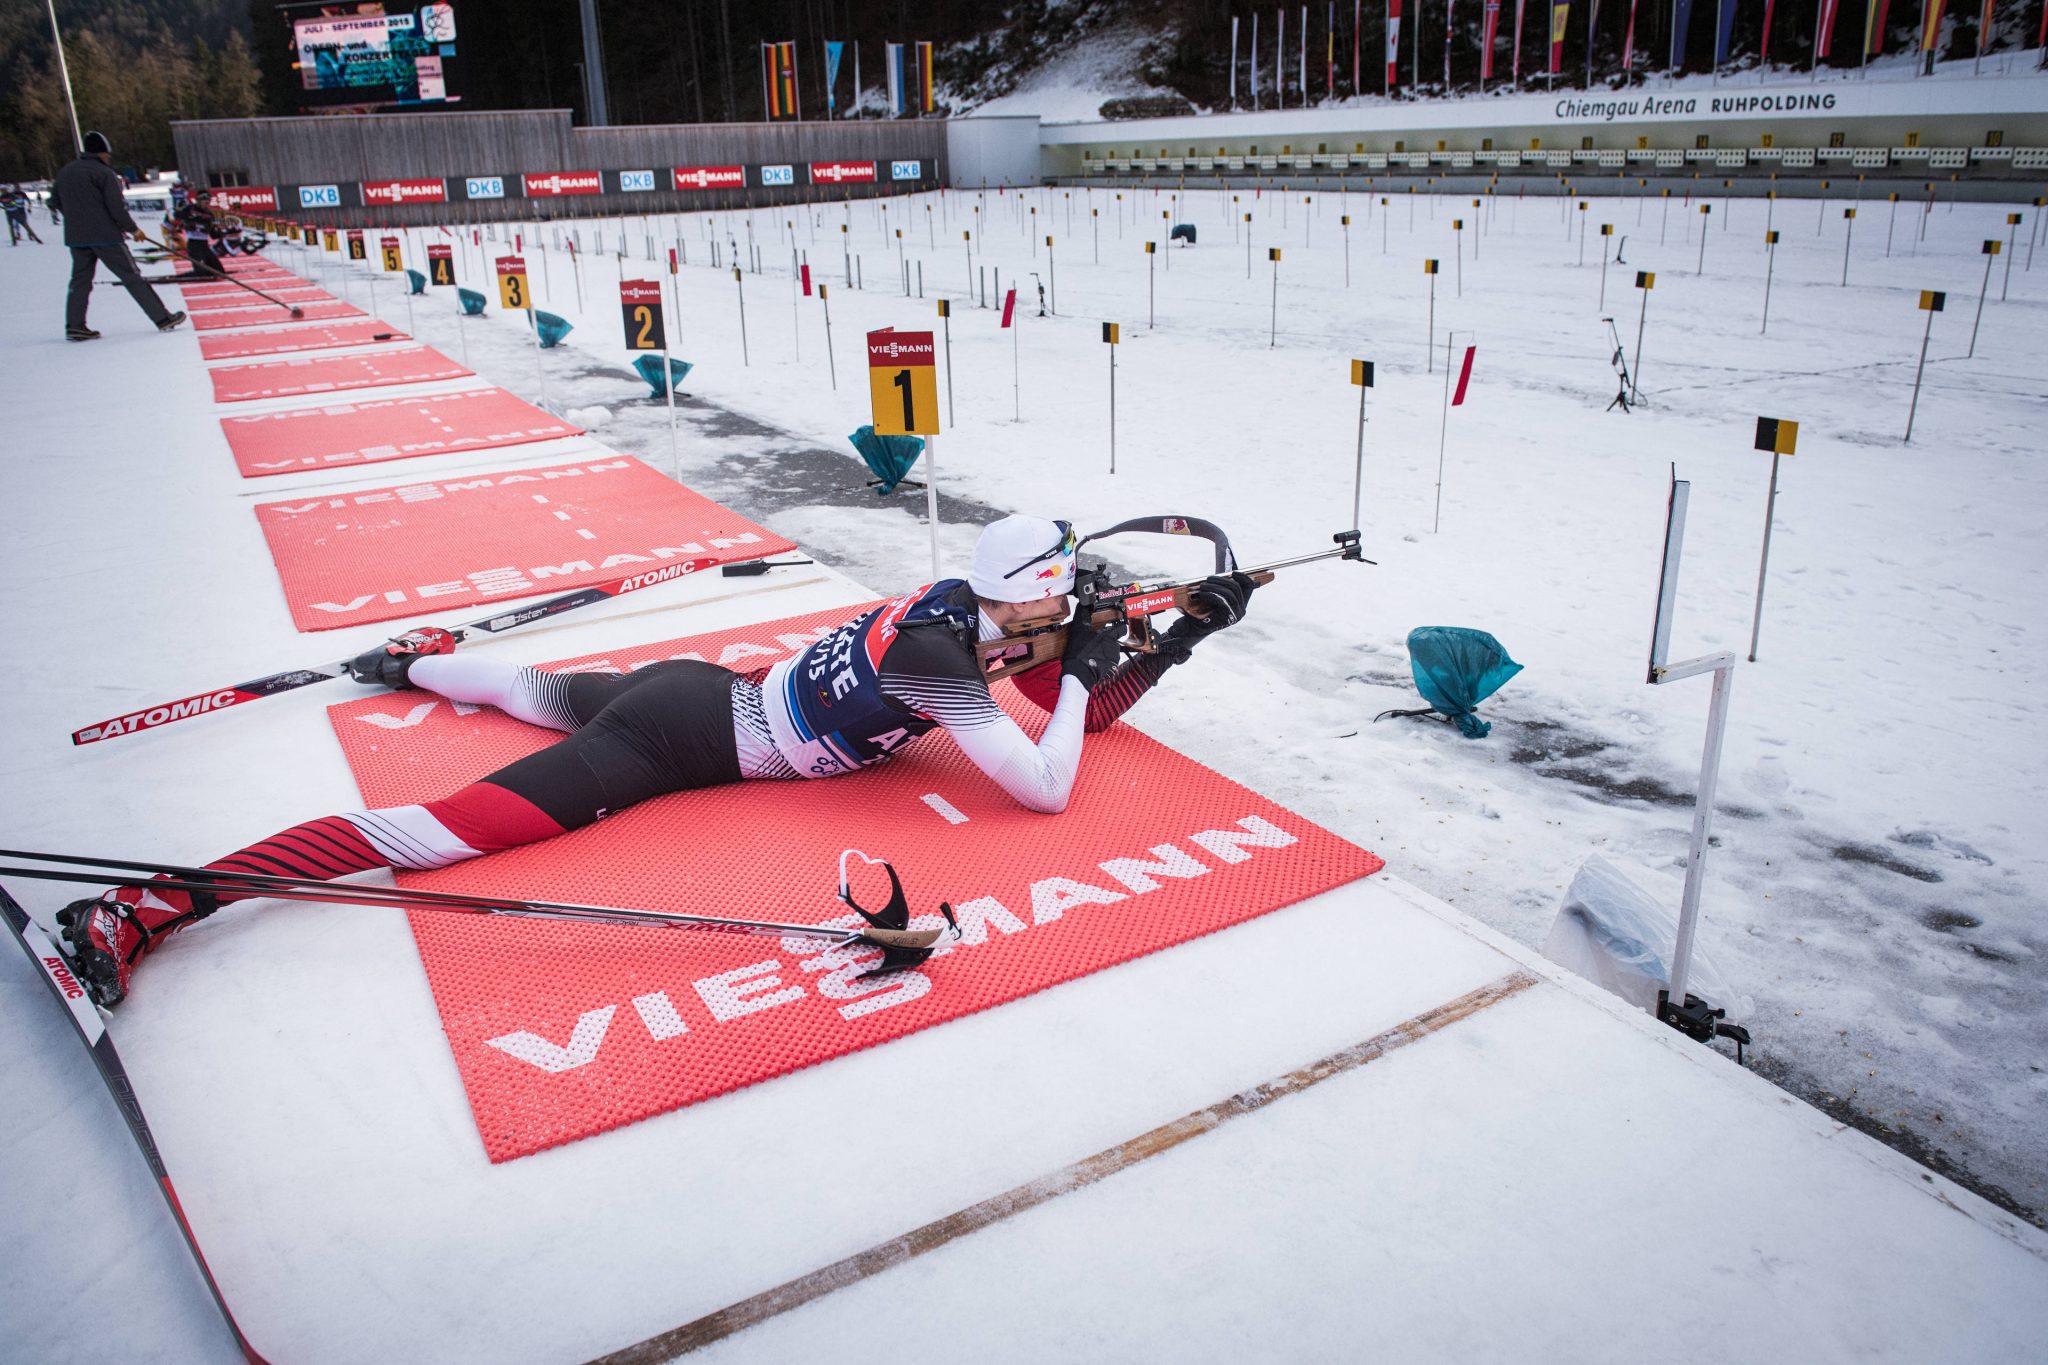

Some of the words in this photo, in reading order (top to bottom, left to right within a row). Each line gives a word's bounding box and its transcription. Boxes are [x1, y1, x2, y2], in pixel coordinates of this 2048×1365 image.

[304, 26, 323, 34] JULI
[332, 20, 385, 31] SEPTEMBER
[1555, 99, 1638, 121] Chiemgau
[1642, 97, 1696, 115] Arena
[1711, 94, 1836, 113] RUHPOLDING
[676, 169, 742, 187] VIESSMANN
[764, 167, 793, 182] DKB
[813, 164, 873, 181] VIESSMANN
[894, 164, 919, 176] DKB
[468, 179, 502, 195] DKB
[527, 175, 598, 194] VIESSMANN
[622, 175, 652, 189] DKB
[301, 187, 337, 204] DKB
[366, 182, 443, 202] VIESSMANN
[328, 235, 335, 251] 7
[352, 240, 361, 258] 6
[387, 249, 397, 271] 5
[436, 258, 449, 285] 4
[506, 275, 522, 307] 3
[621, 286, 660, 299] VIESSMANN
[634, 305, 655, 348] 2
[870, 342, 933, 357] VIESSMANN
[893, 369, 915, 431] 1
[275, 460, 630, 515] VIESSMANN
[308, 531, 764, 613] VIESSMANN
[618, 561, 695, 594] ATOMIC
[1127, 595, 1173, 611] VIESSMANN
[100, 690, 236, 740] ATOMIC
[485, 814, 1298, 1075] VIESSMANN
[43, 956, 84, 1000] ATOMIC
